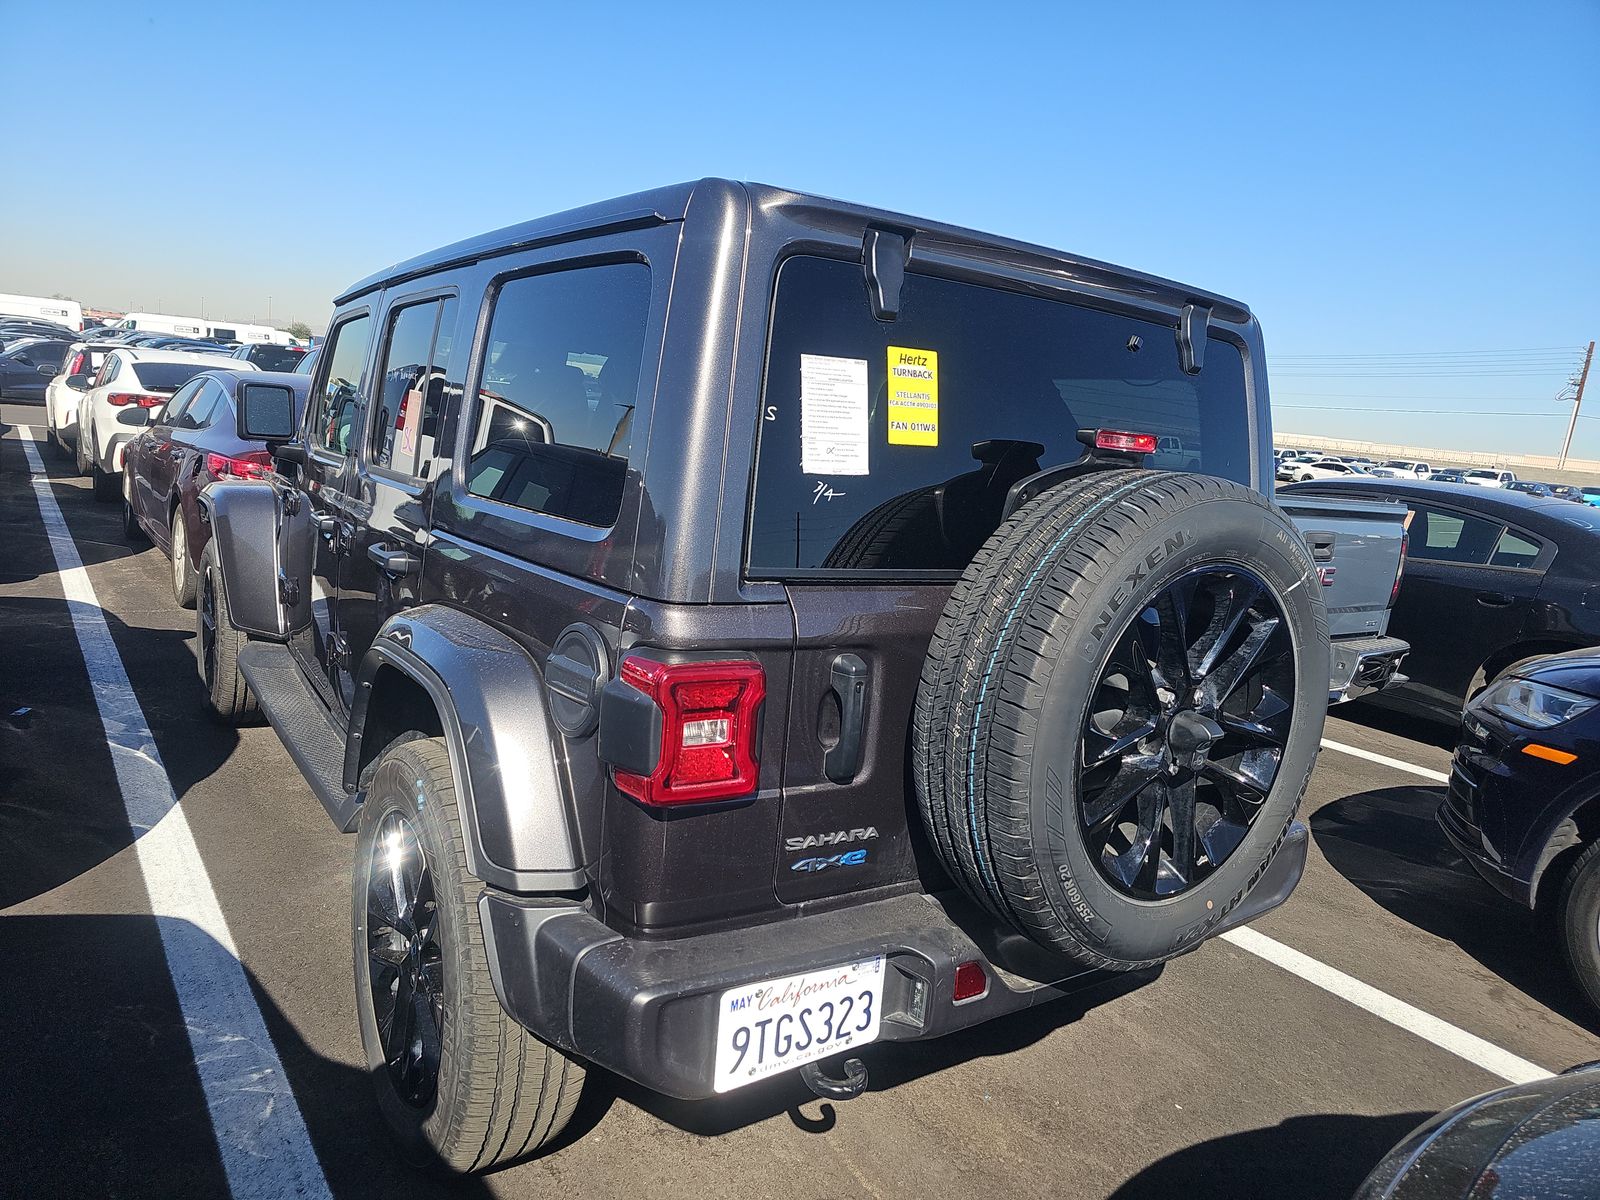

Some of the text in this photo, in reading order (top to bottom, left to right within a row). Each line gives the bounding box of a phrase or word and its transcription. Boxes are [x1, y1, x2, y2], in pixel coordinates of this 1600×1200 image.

[892, 367, 934, 380] TURNBACK
[899, 353, 928, 367] Hertz
[896, 391, 931, 401] STELLANTIS
[765, 405, 778, 421] S
[890, 421, 937, 432] FAN 011W8
[1089, 530, 1185, 642] NEXEN
[784, 825, 880, 852] SAHARA
[1058, 863, 1096, 923] 255/60R20
[729, 971, 859, 1014] MAY California
[728, 989, 874, 1075] 9TGS323
[759, 1040, 843, 1073] dmv.ca.gov
